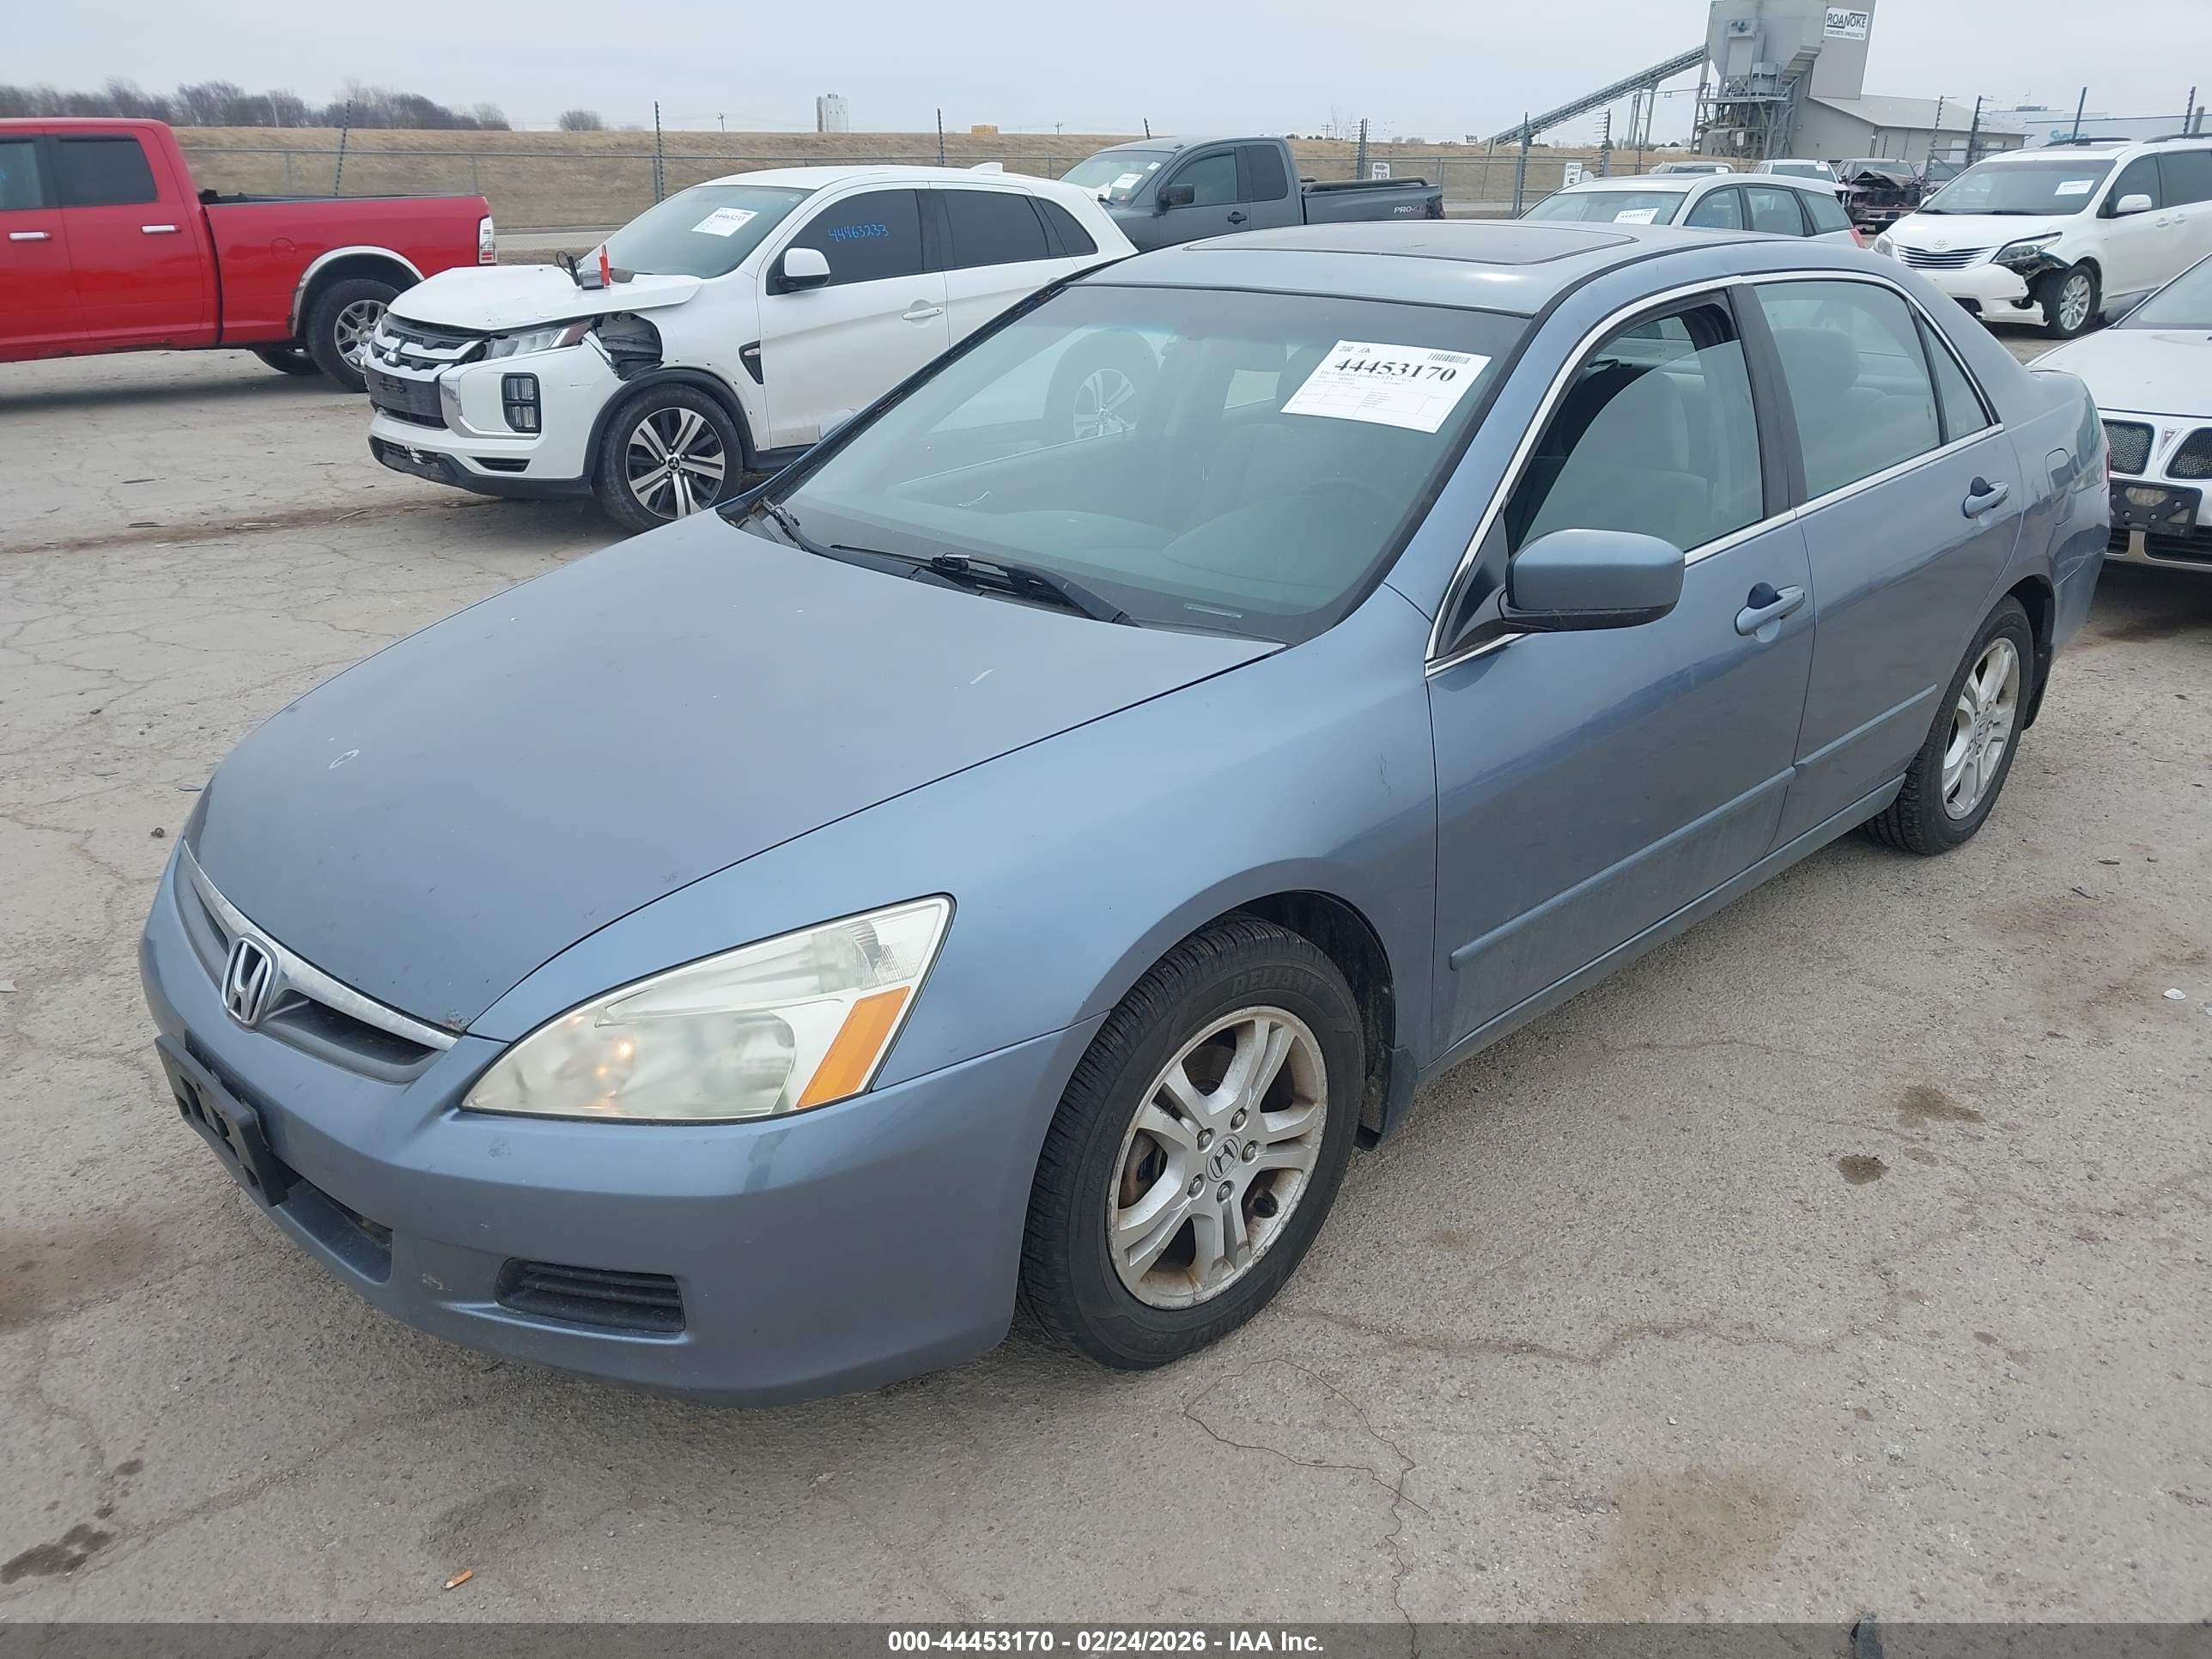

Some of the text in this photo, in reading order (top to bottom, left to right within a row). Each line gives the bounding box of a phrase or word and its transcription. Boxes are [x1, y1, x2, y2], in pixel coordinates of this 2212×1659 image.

[1826, 13, 1867, 28] ROANOKE
[828, 224, 890, 242] 44463233
[1334, 358, 1457, 382] 44453170
